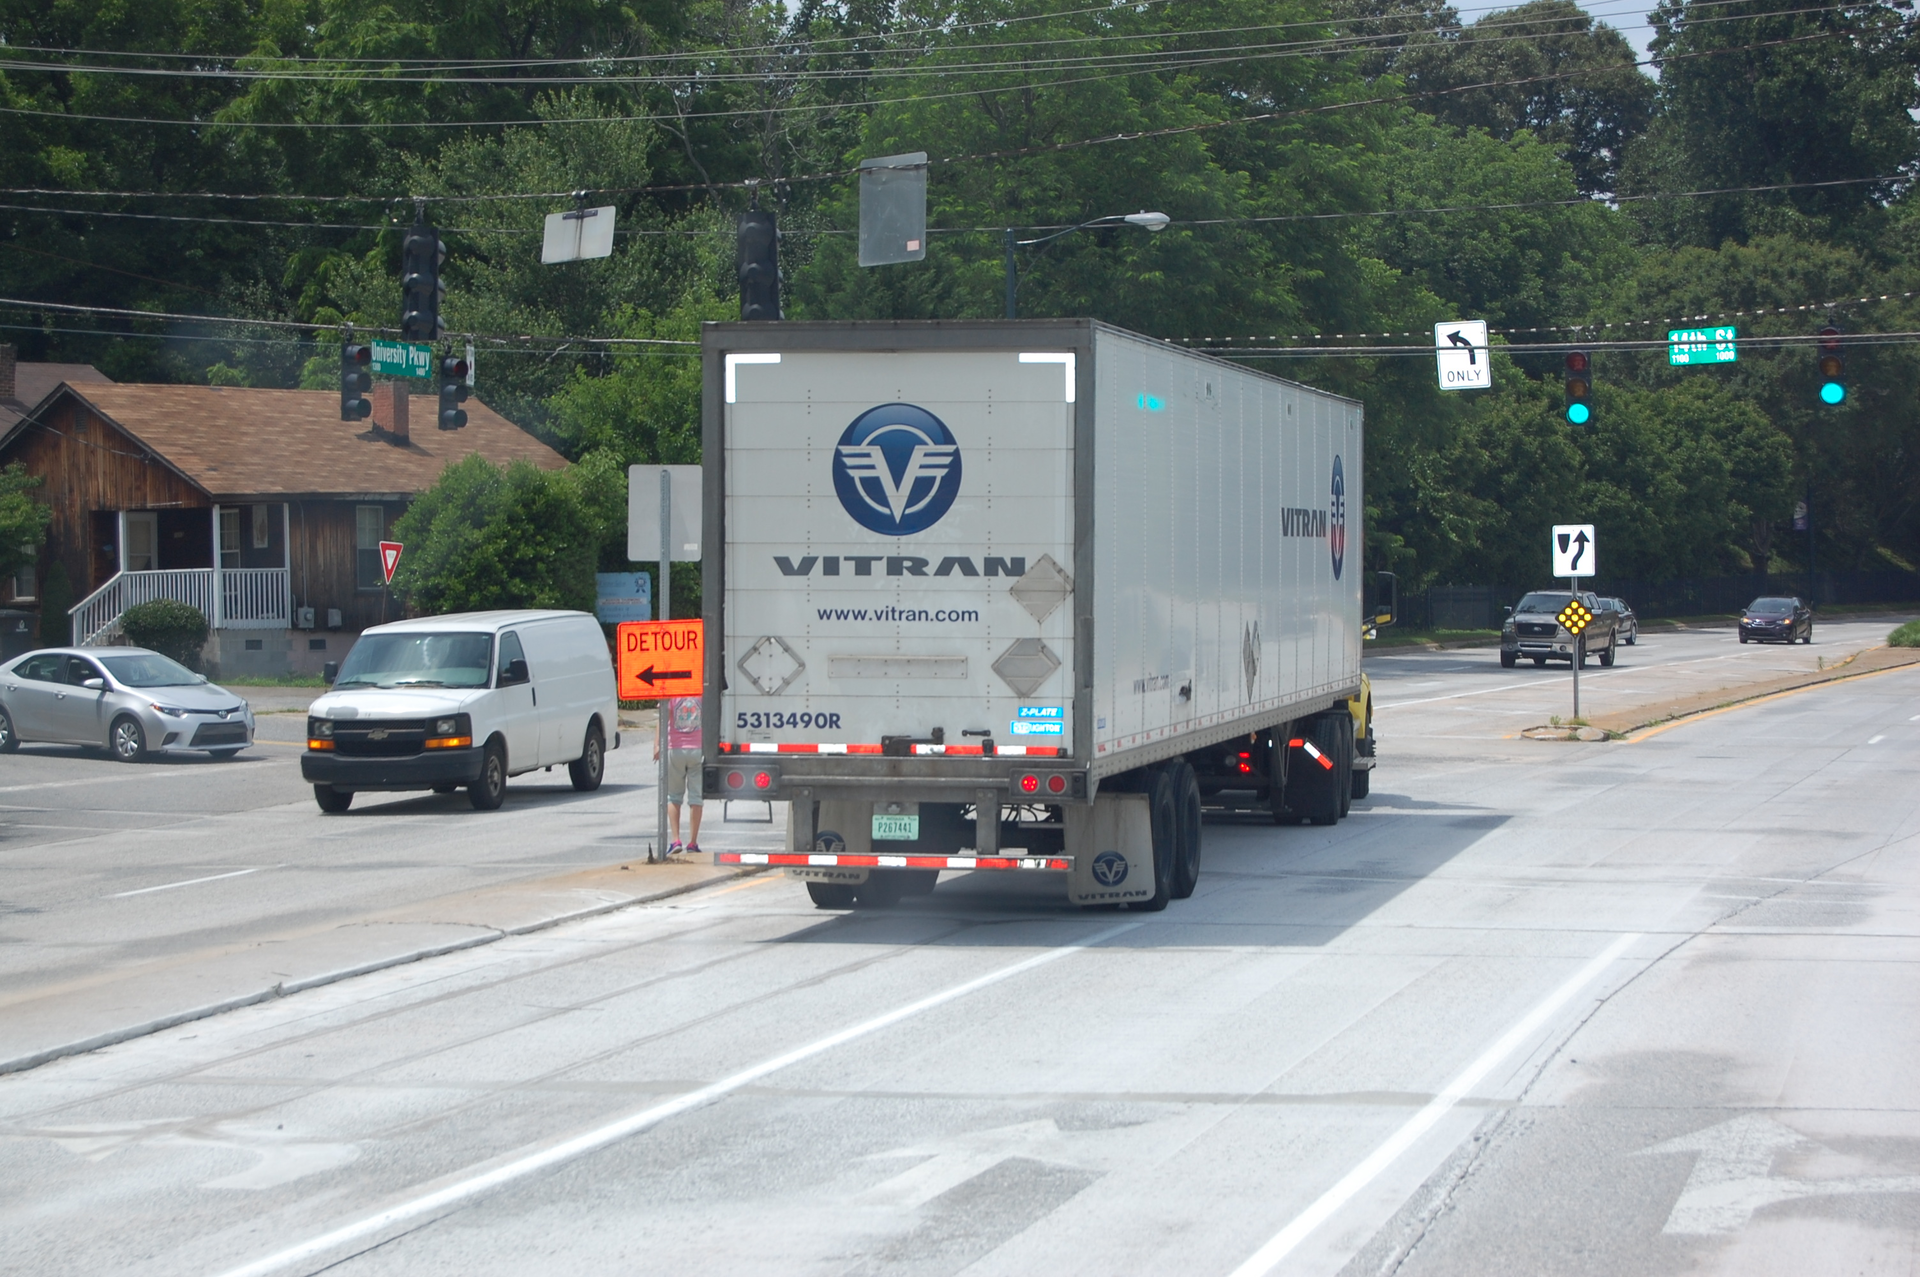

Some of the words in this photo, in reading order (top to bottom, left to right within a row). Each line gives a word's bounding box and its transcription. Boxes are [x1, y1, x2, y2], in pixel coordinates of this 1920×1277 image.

[1671, 331, 1707, 353] 14th
[1715, 329, 1734, 350] St
[371, 341, 407, 369] University
[408, 345, 430, 371] Pkwy
[1715, 350, 1735, 361] 1000
[1447, 369, 1481, 382] ONLY
[1281, 507, 1326, 538] VITRAN
[772, 556, 1026, 577] VITRAN
[817, 606, 979, 622] www.vitran.com
[627, 630, 698, 652] DETOUR
[1020, 707, 1058, 717] Z-PLATE
[737, 712, 841, 729] 5313490R
[878, 822, 912, 833] P267441
[792, 869, 861, 880] VITRAN
[1078, 890, 1147, 900] VITRAN
